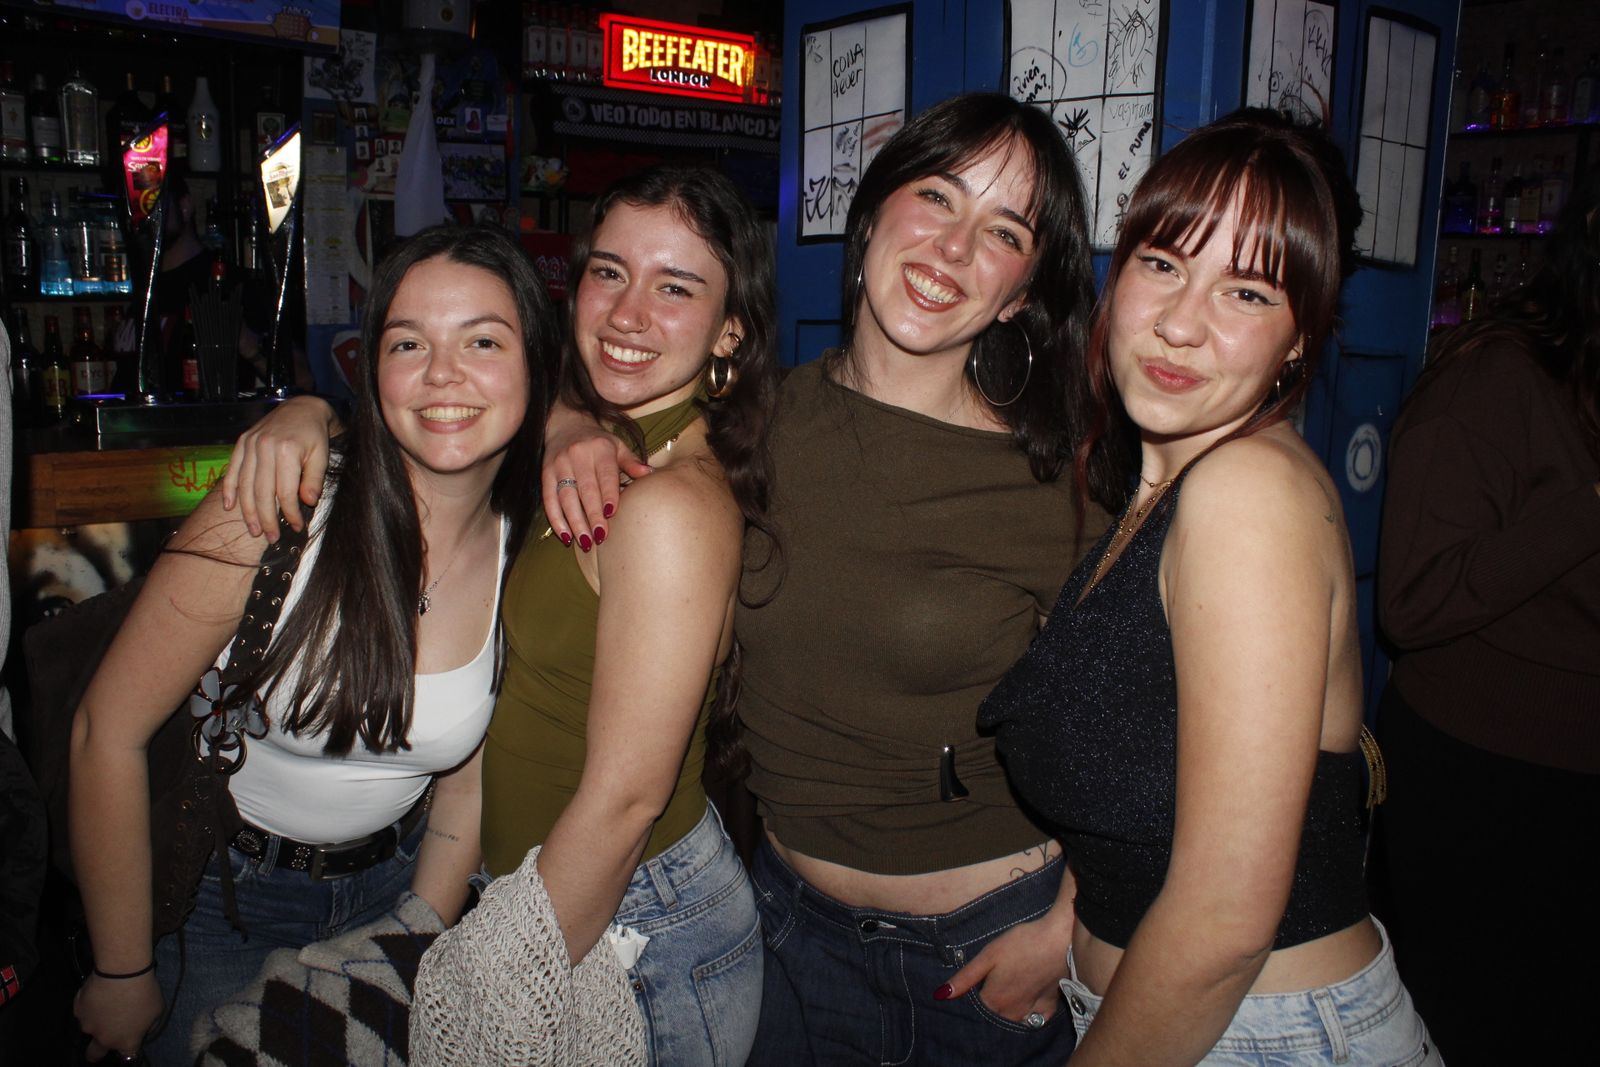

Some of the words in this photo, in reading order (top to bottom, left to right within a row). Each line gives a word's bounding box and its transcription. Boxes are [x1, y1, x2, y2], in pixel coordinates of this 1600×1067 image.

[621, 28, 744, 87] BEEFEATER
[649, 68, 713, 88] LONDON
[590, 103, 625, 124] VEO
[626, 105, 672, 129] TODO
[674, 110, 698, 129] EN
[699, 111, 766, 136] BLANCO
[1129, 121, 1153, 157] PUMA
